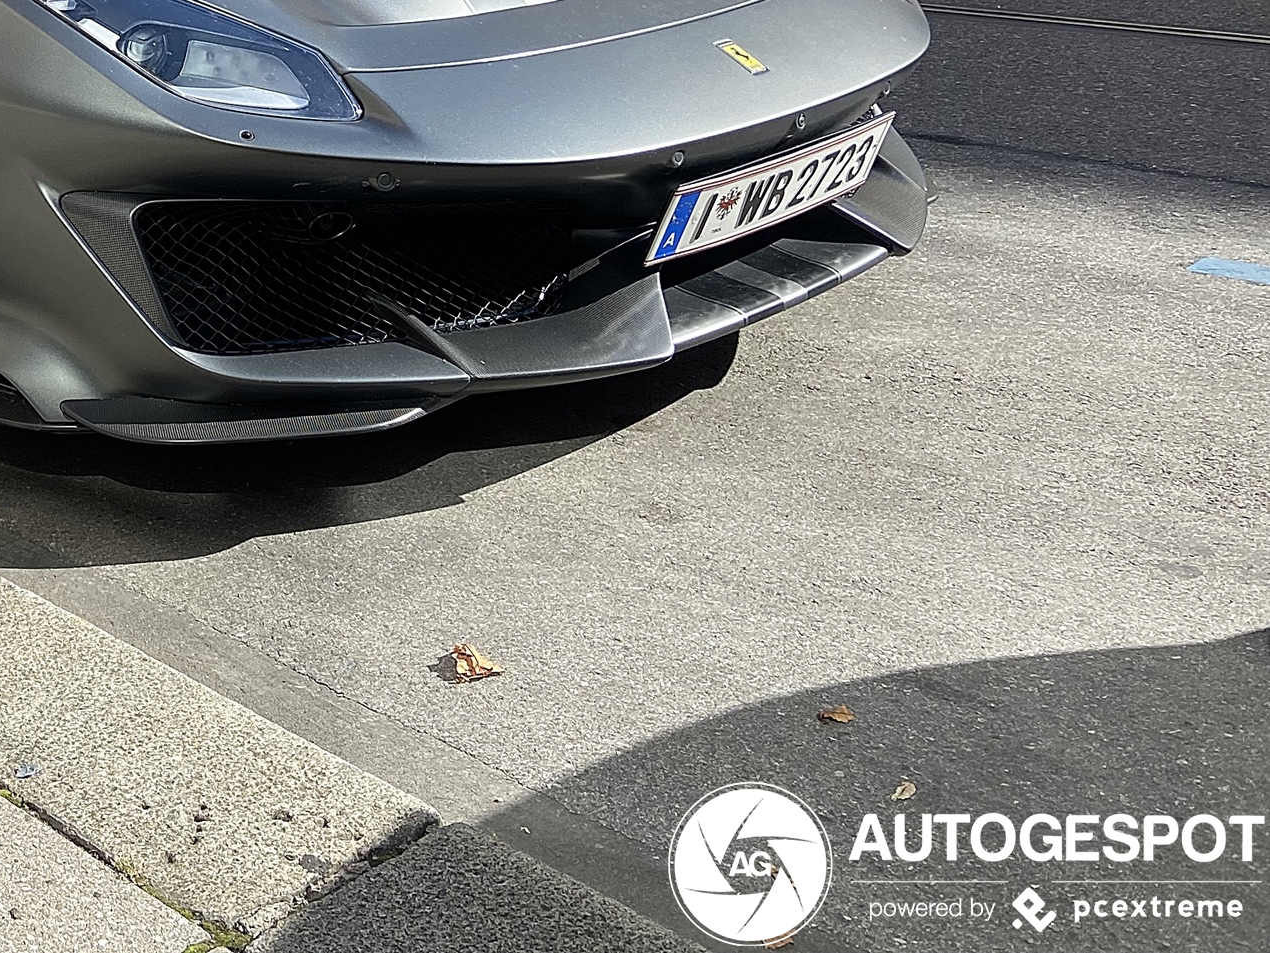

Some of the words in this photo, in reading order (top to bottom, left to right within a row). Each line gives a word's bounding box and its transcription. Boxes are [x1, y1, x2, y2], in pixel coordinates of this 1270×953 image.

[734, 170, 794, 230] WB
[785, 135, 874, 210] 2723
[663, 235, 675, 248] A
